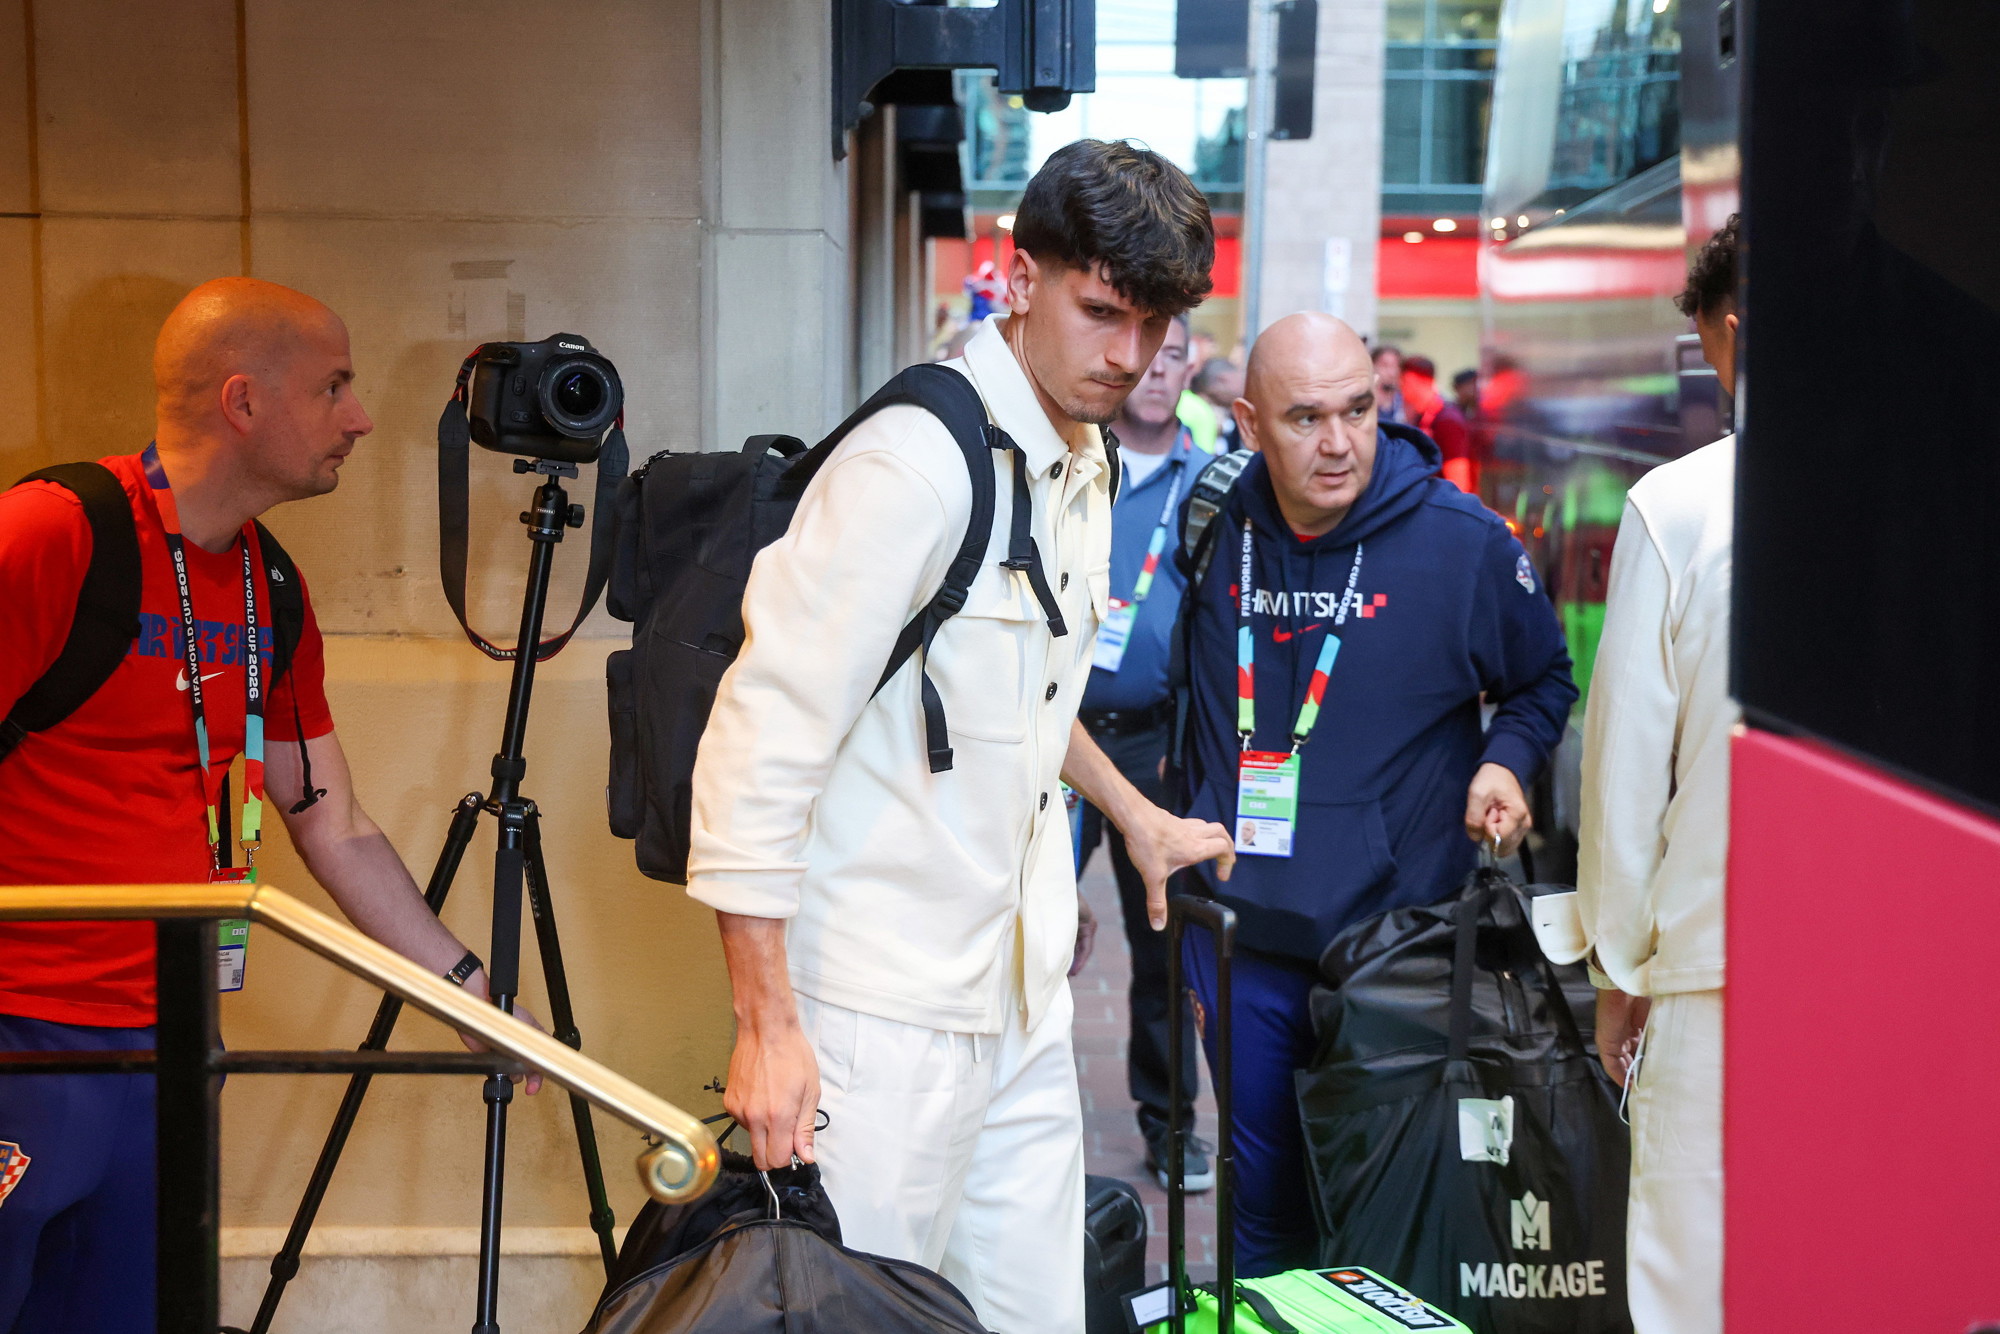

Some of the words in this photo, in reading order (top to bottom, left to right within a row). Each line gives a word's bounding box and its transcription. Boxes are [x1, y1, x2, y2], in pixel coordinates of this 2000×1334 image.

[559, 341, 585, 351] Canon
[1242, 531, 1252, 553] CUP
[174, 548, 189, 597] 2026
[243, 548, 251, 576] FIFA
[1241, 554, 1251, 593] WORLD
[1348, 565, 1360, 588] CUP
[182, 598, 194, 625] CUP
[245, 578, 255, 625] WORLD
[1241, 594, 1251, 617] FIFA
[186, 626, 198, 675] WORLD
[247, 626, 256, 652] CUP
[192, 676, 202, 705] FIFA
[248, 653, 259, 700] 2026
[1459, 1260, 1607, 1299] MACKAGE
